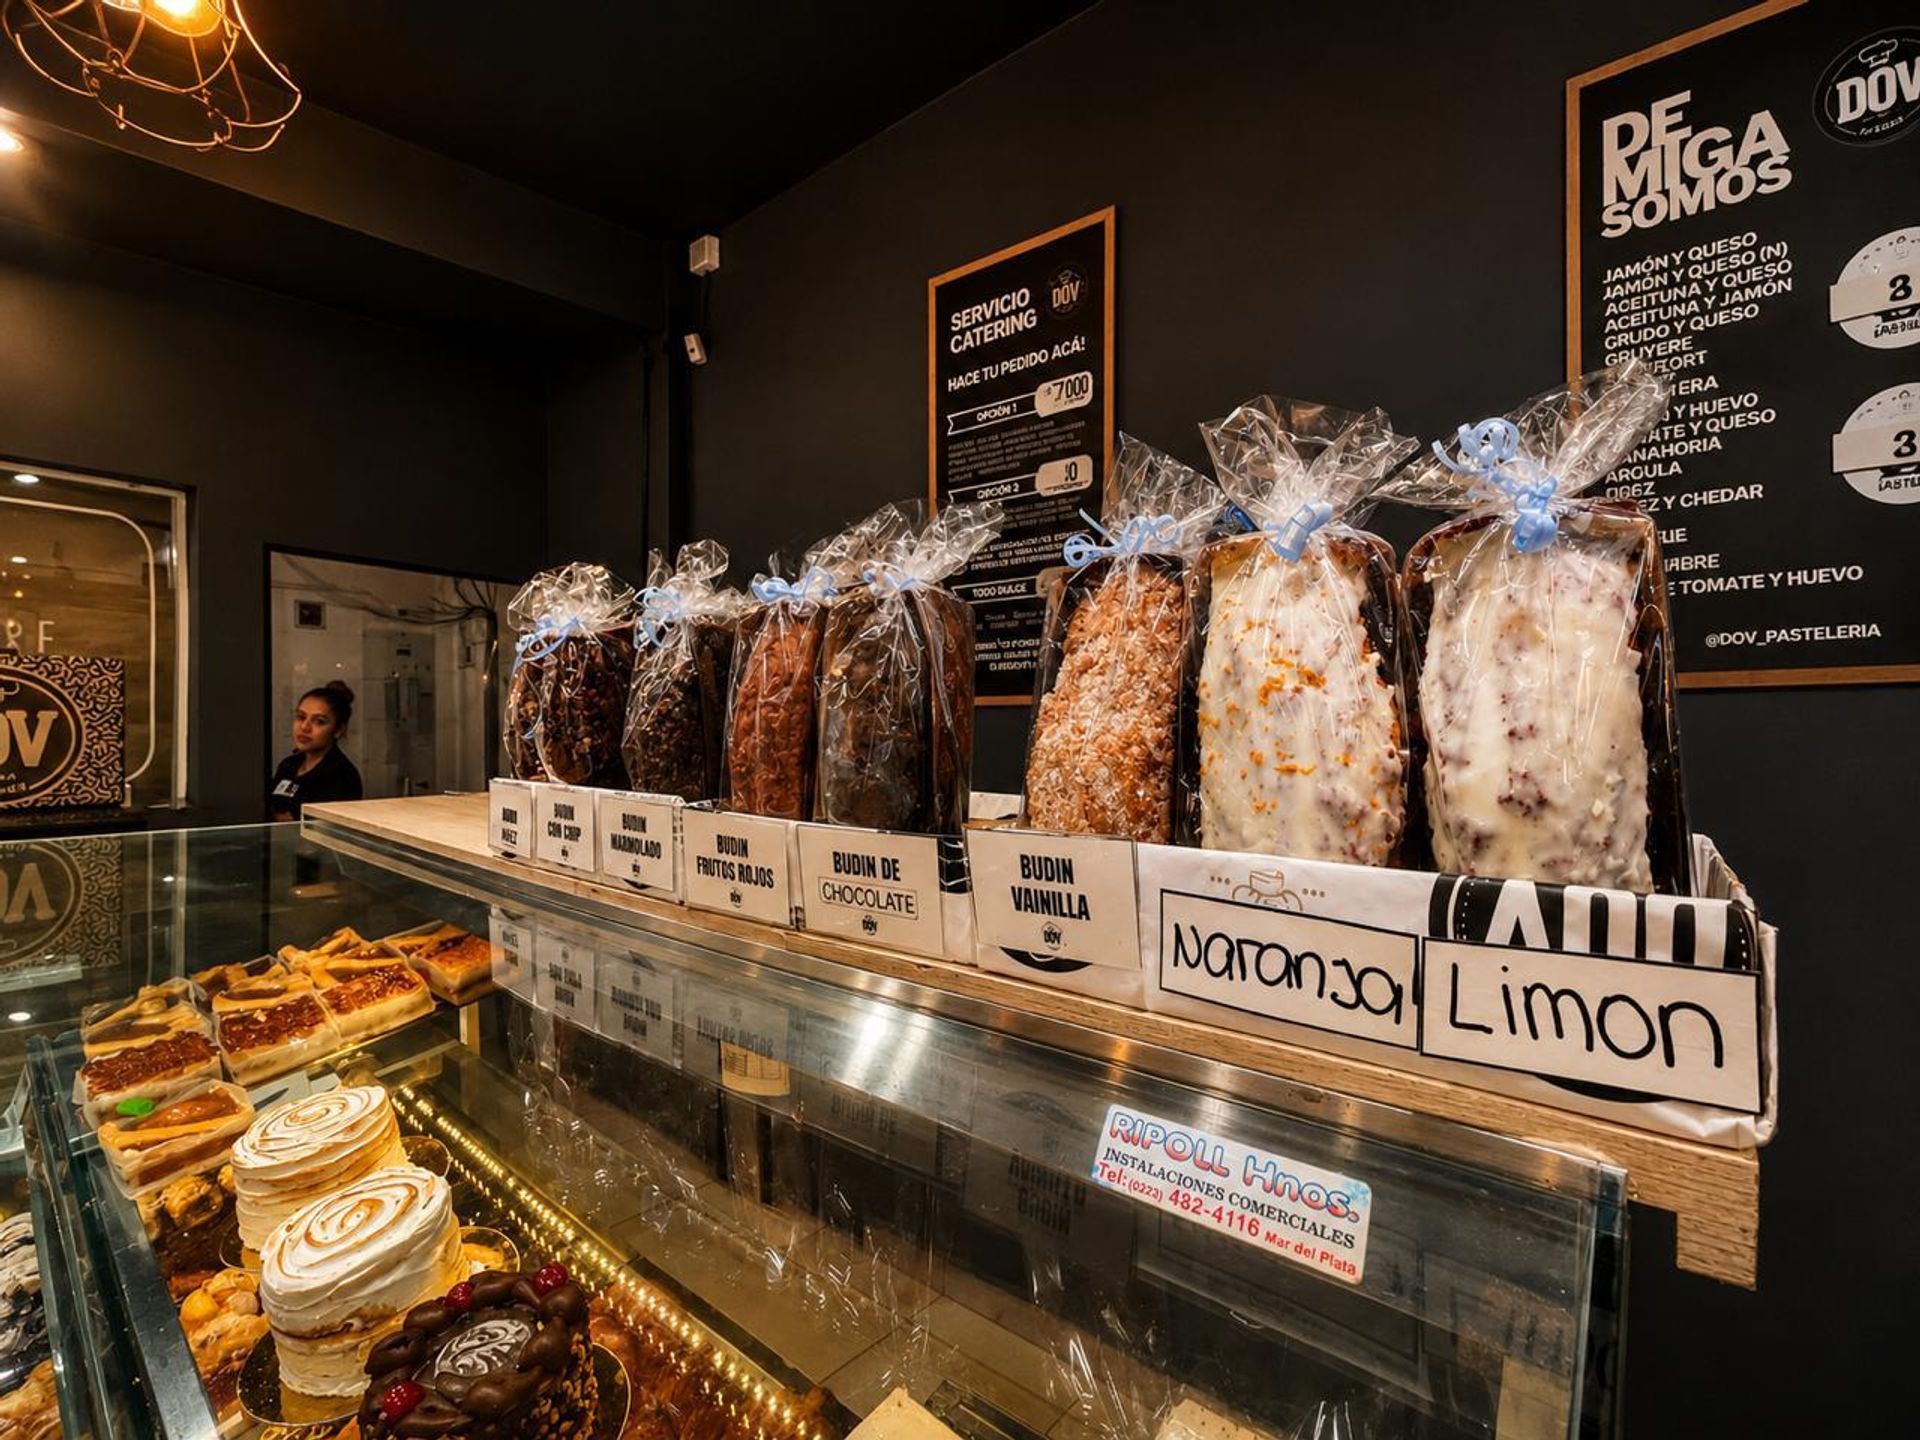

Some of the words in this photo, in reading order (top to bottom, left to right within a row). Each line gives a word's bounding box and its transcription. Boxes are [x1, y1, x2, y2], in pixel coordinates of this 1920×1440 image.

[1603, 90, 1692, 160] DE
[1603, 110, 1791, 207] MIGA
[1601, 155, 1793, 238] SOMOS
[1603, 255, 1668, 284] JAMÓN
[1671, 250, 1685, 266] Y
[1688, 232, 1757, 262] QUESO
[1672, 268, 1685, 283] Y
[1688, 250, 1757, 280] QUESO
[1759, 241, 1788, 262] (N)
[1052, 280, 1080, 309] DOV
[1604, 282, 1702, 316] ACEITUNA
[1705, 277, 1719, 292] Y
[1722, 259, 1792, 288] QUESO
[1604, 299, 1700, 333] ACEITUNA
[1704, 295, 1717, 309] Y
[1720, 278, 1792, 307] JAMÓN
[950, 288, 1030, 331] SERVICIO
[1674, 320, 1686, 334] Y
[1690, 303, 1760, 331] QUESO
[950, 308, 1037, 354] CATERING
[948, 371, 980, 392] HACE
[982, 363, 999, 381] TU
[1001, 349, 1049, 376] PEDIDO
[1051, 335, 1086, 360] ACÁ!
[1673, 404, 1686, 420] Y
[1689, 392, 1759, 418] HUEVO
[1689, 420, 1702, 436] Y
[1705, 408, 1776, 434] QUESO
[1663, 495, 1676, 511] Y
[1679, 484, 1764, 509] CHEDAR
[1679, 573, 1765, 594] TOMATE
[1768, 571, 1783, 587] Y
[1787, 565, 1864, 586] HUEVO
[1705, 623, 1881, 648] @DOV_PASTELERIA
[717, 834, 748, 858] BUDIN
[832, 851, 877, 878] BUDIN
[881, 857, 901, 881] DE
[696, 855, 736, 881] FRUTOS
[738, 863, 774, 889] ROJOS
[1020, 854, 1074, 885] BUDIN
[822, 882, 915, 914] CHOCOLATE
[1011, 886, 1091, 921] VAINILLA
[1449, 962, 1724, 1069] Limon
[1110, 1111, 1230, 1178] RIPOLL
[1243, 1154, 1361, 1223] Hnos.
[1097, 1160, 1126, 1187] Tel:
[1168, 1188, 1261, 1237] 482-4116
[1264, 1229, 1291, 1250] Mar
[1294, 1242, 1316, 1260] del
[1319, 1250, 1358, 1277] Plata
[1104, 1146, 1226, 1201] INSTALACIONES
[1228, 1191, 1356, 1249] COMERCIALES
